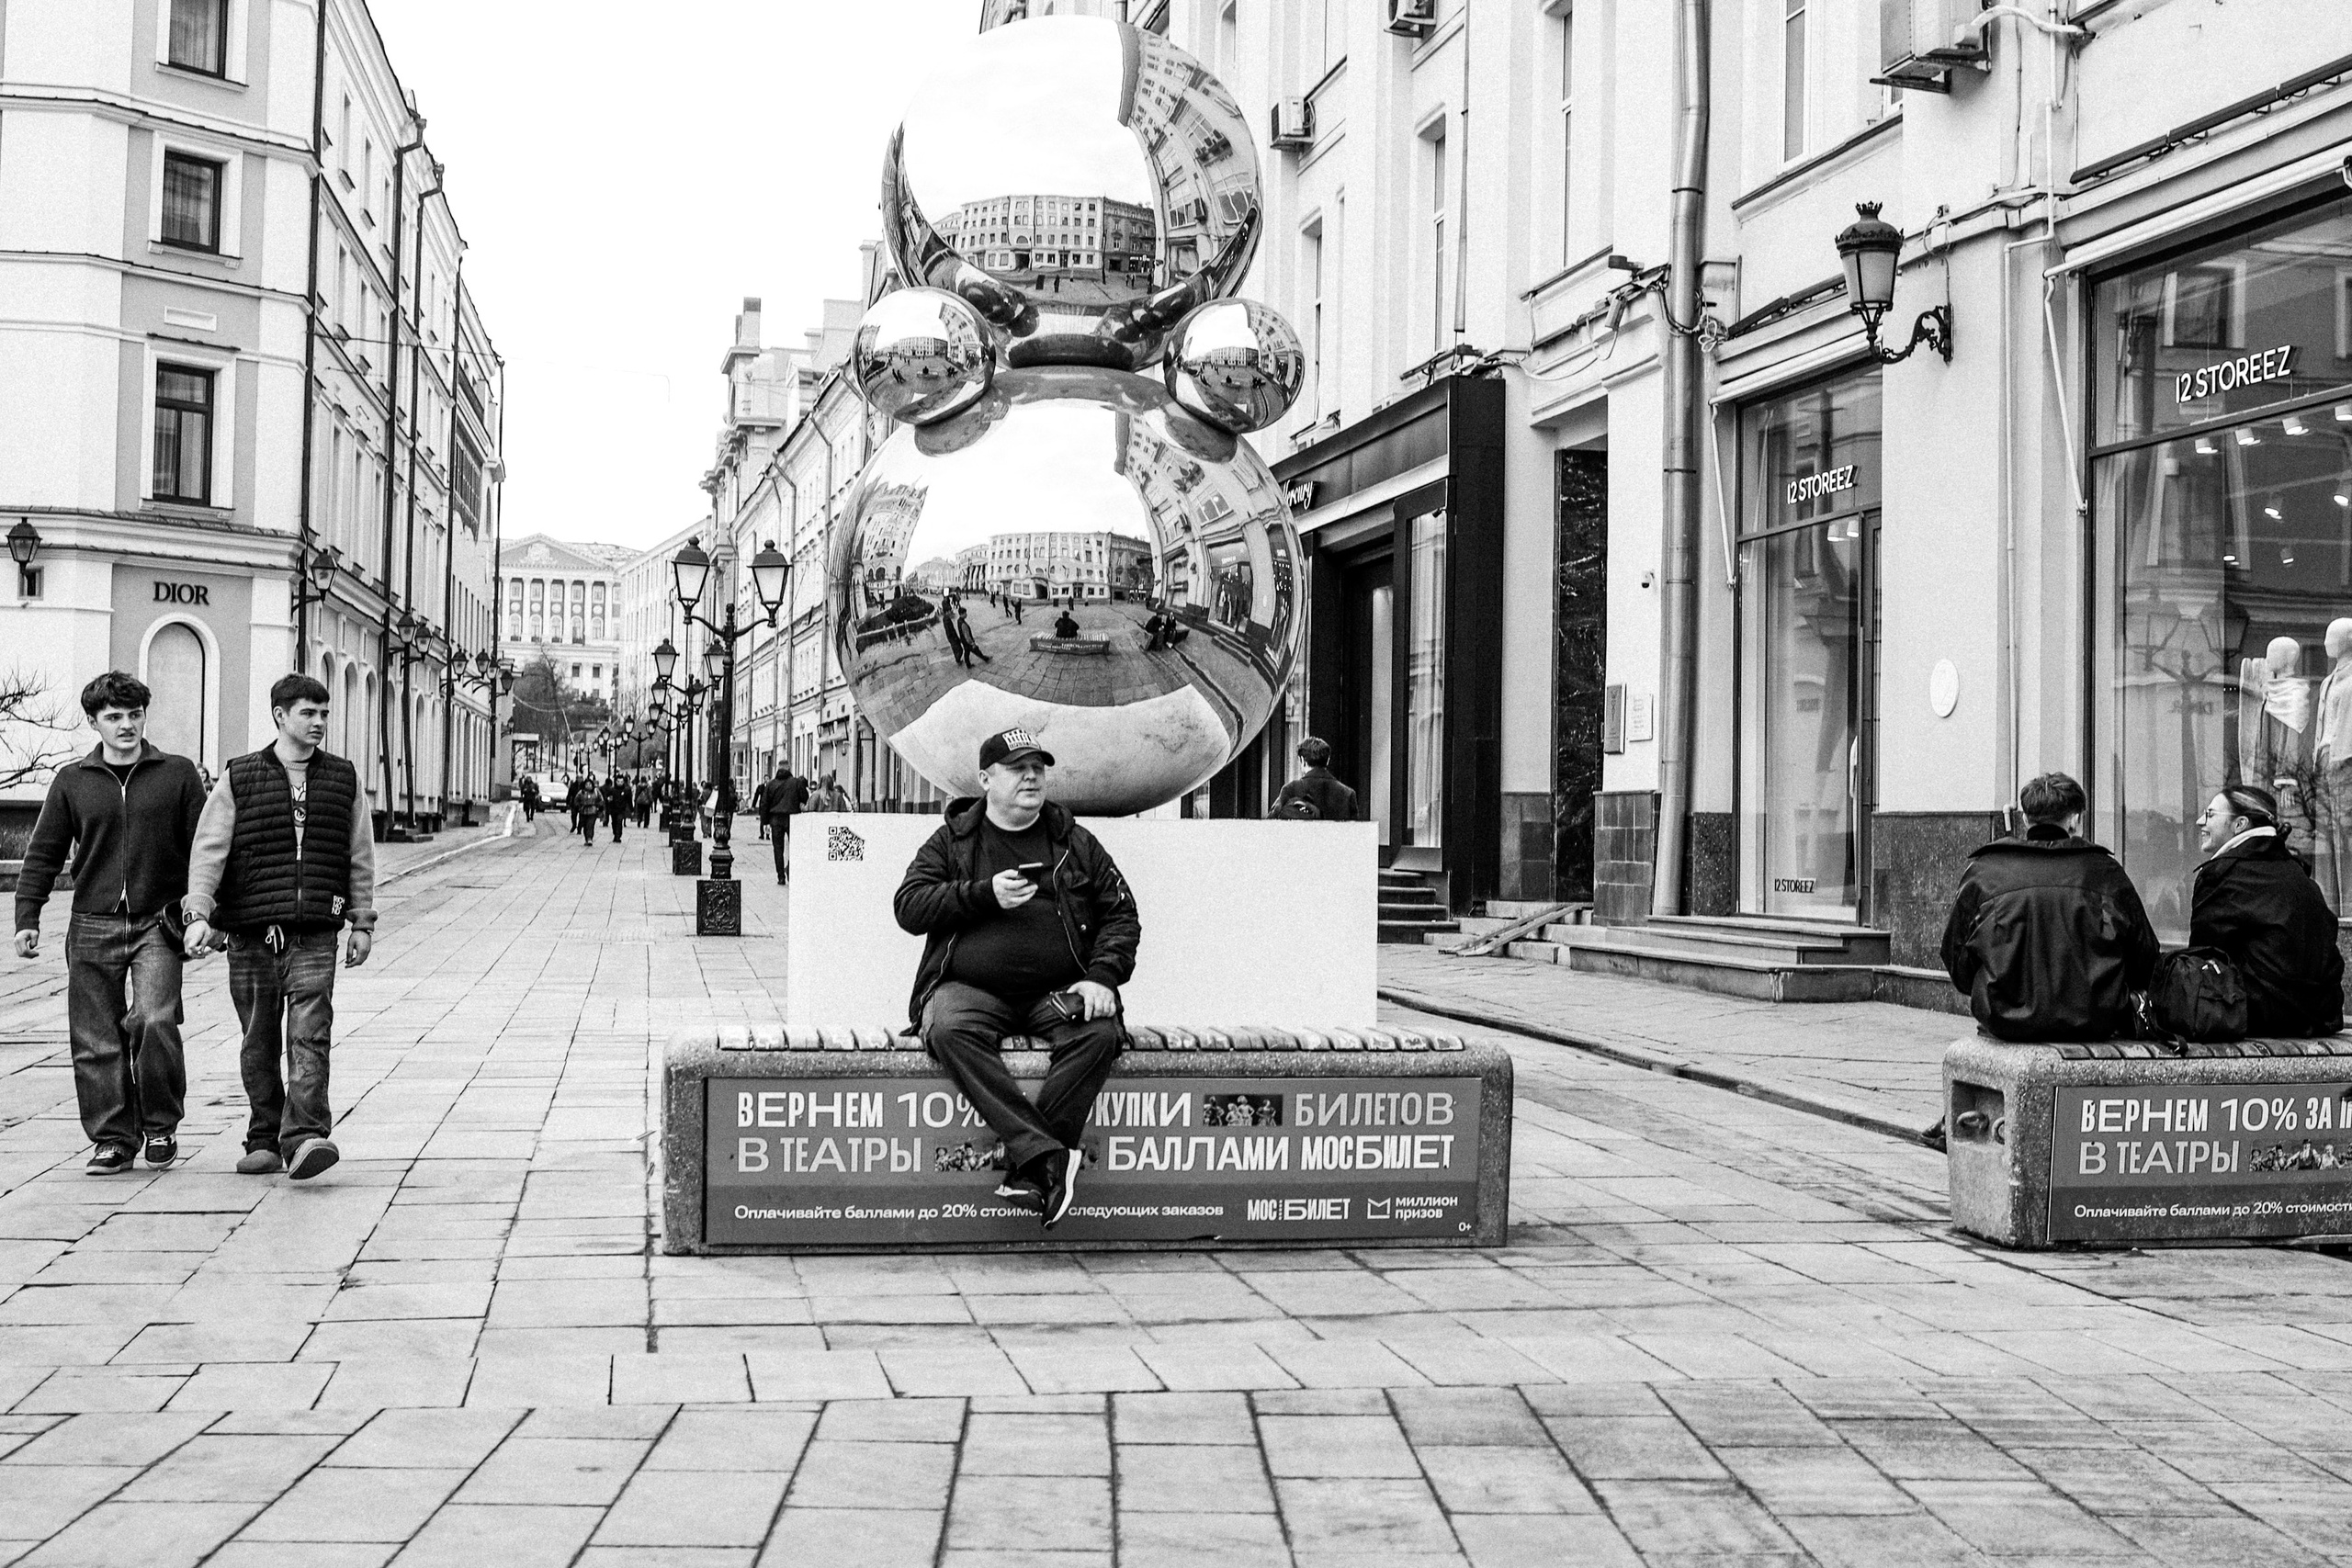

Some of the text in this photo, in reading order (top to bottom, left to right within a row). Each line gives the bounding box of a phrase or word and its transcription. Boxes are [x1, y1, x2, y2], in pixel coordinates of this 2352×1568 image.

[2176, 344, 2291, 404] 12 STOREEZ
[1787, 464, 1854, 505] 12 STOREEZ
[153, 581, 209, 606] DIOR
[1774, 878, 1815, 894] 12 STOREEZ
[737, 1091, 1455, 1128] ВЕРНЕМ 10% КУПКИ БИЛЕТОВ
[2080, 1099, 2209, 1133] ВЕРНЕМ
[2220, 1097, 2298, 1132] 10%
[2305, 1097, 2333, 1130] ЗА
[738, 1134, 1455, 1173] В ТЕАТРЫ БАЛЛАМИ МОСБИЛЕТ
[2079, 1140, 2240, 1175] В ТЕАТРЫ
[734, 1203, 1224, 1221] Оплачивайте баллами до 20% стоимо следующих заказов
[1395, 1207, 1443, 1222] призов
[1396, 1196, 1458, 1207] миллион
[2074, 1201, 2352, 1218] Оплачивайте баллами до 20% стоимост
